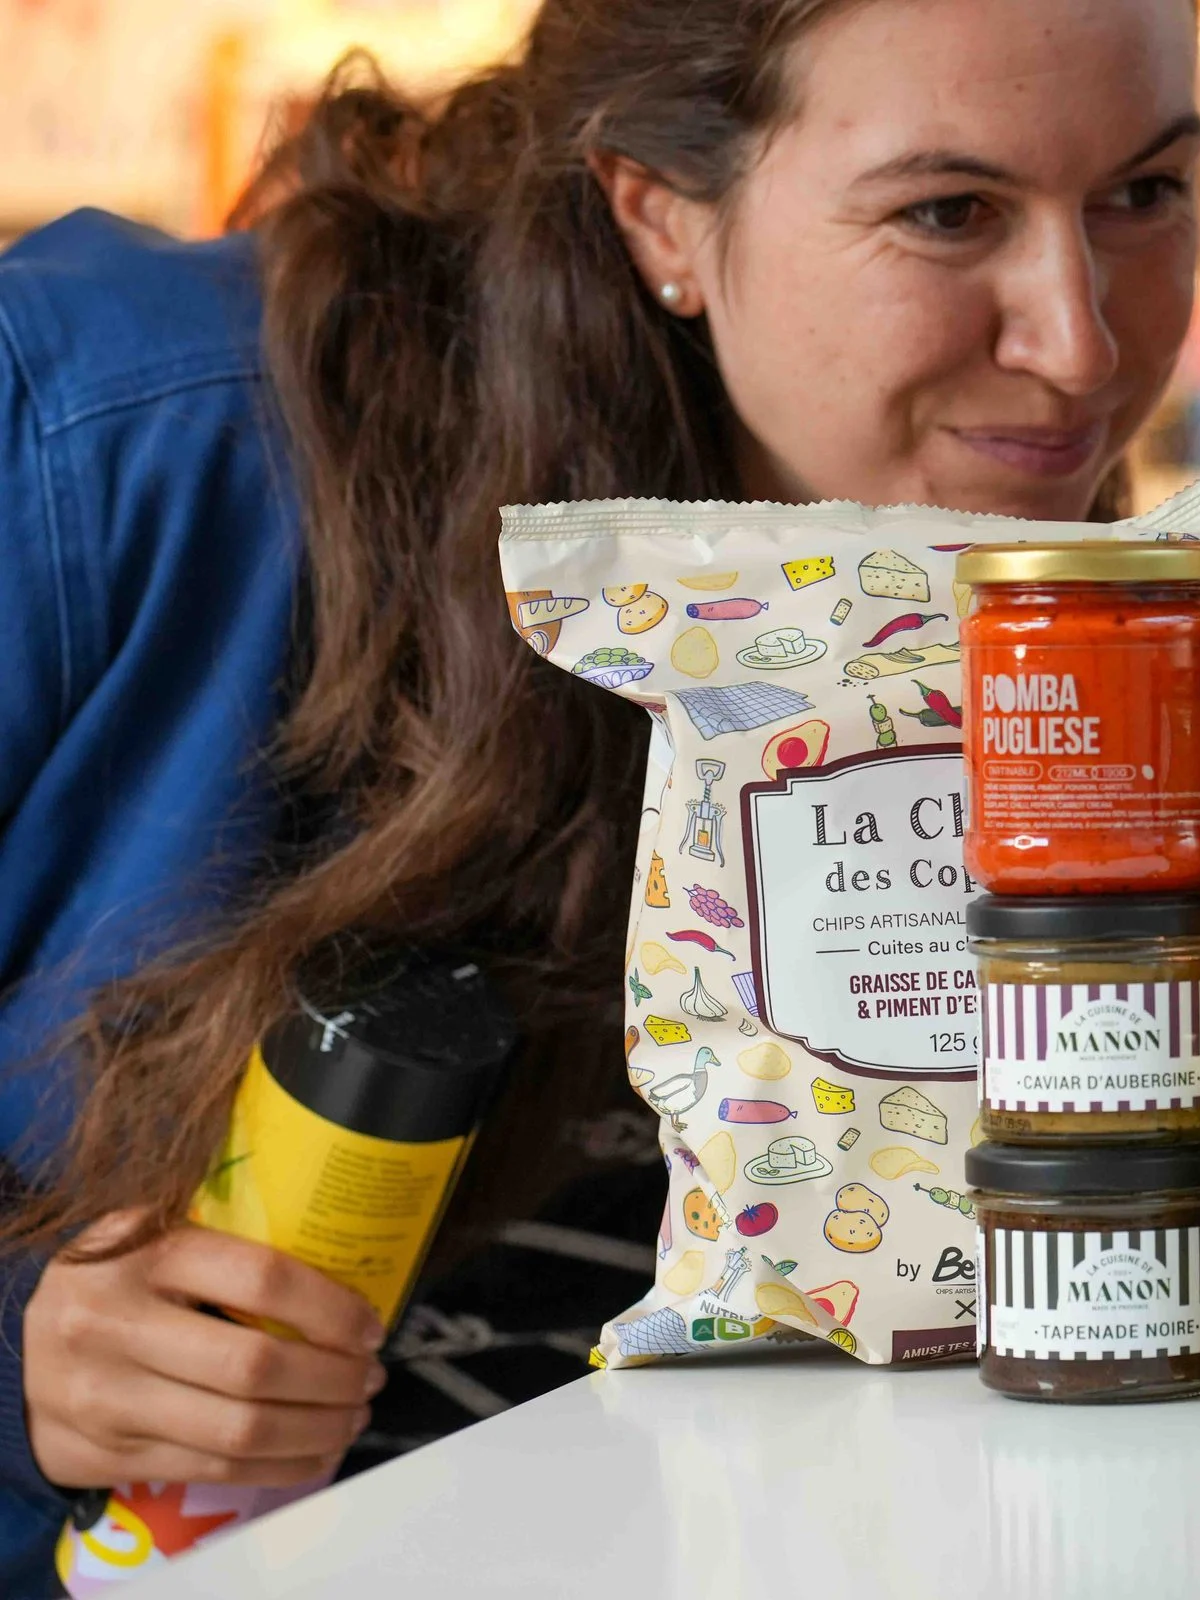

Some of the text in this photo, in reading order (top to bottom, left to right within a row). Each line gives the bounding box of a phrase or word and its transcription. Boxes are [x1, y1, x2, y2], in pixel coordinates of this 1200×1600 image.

[982, 674, 1078, 713] BOMBA
[982, 717, 1100, 755] PUGLIESE
[811, 804, 883, 846] La
[825, 861, 891, 893] des
[812, 911, 966, 932] CHIPS ARTISANAL
[868, 936, 969, 956] Cuites au c
[850, 972, 920, 994] GRAISSE
[926, 971, 948, 990] DE
[857, 1001, 871, 1019] &
[876, 996, 941, 1018] PIMENT
[1074, 1015, 1087, 1027] LA
[1087, 1004, 1129, 1017] CUISINE
[1129, 1012, 1143, 1026] DE
[930, 1032, 966, 1052] 125
[1055, 1029, 1161, 1052] MANON
[1024, 1071, 1195, 1090] CAVIAR D'AUBERGINE
[897, 1259, 921, 1281] by
[1086, 1264, 1099, 1276] LA
[1100, 1254, 1141, 1266] CUISINE
[1141, 1261, 1154, 1274] DE
[1068, 1277, 1171, 1302] MANON
[693, 1321, 744, 1337] A B
[1041, 1319, 1194, 1340] TAPENADE NOIRE
[902, 1344, 944, 1359] AMUSE
